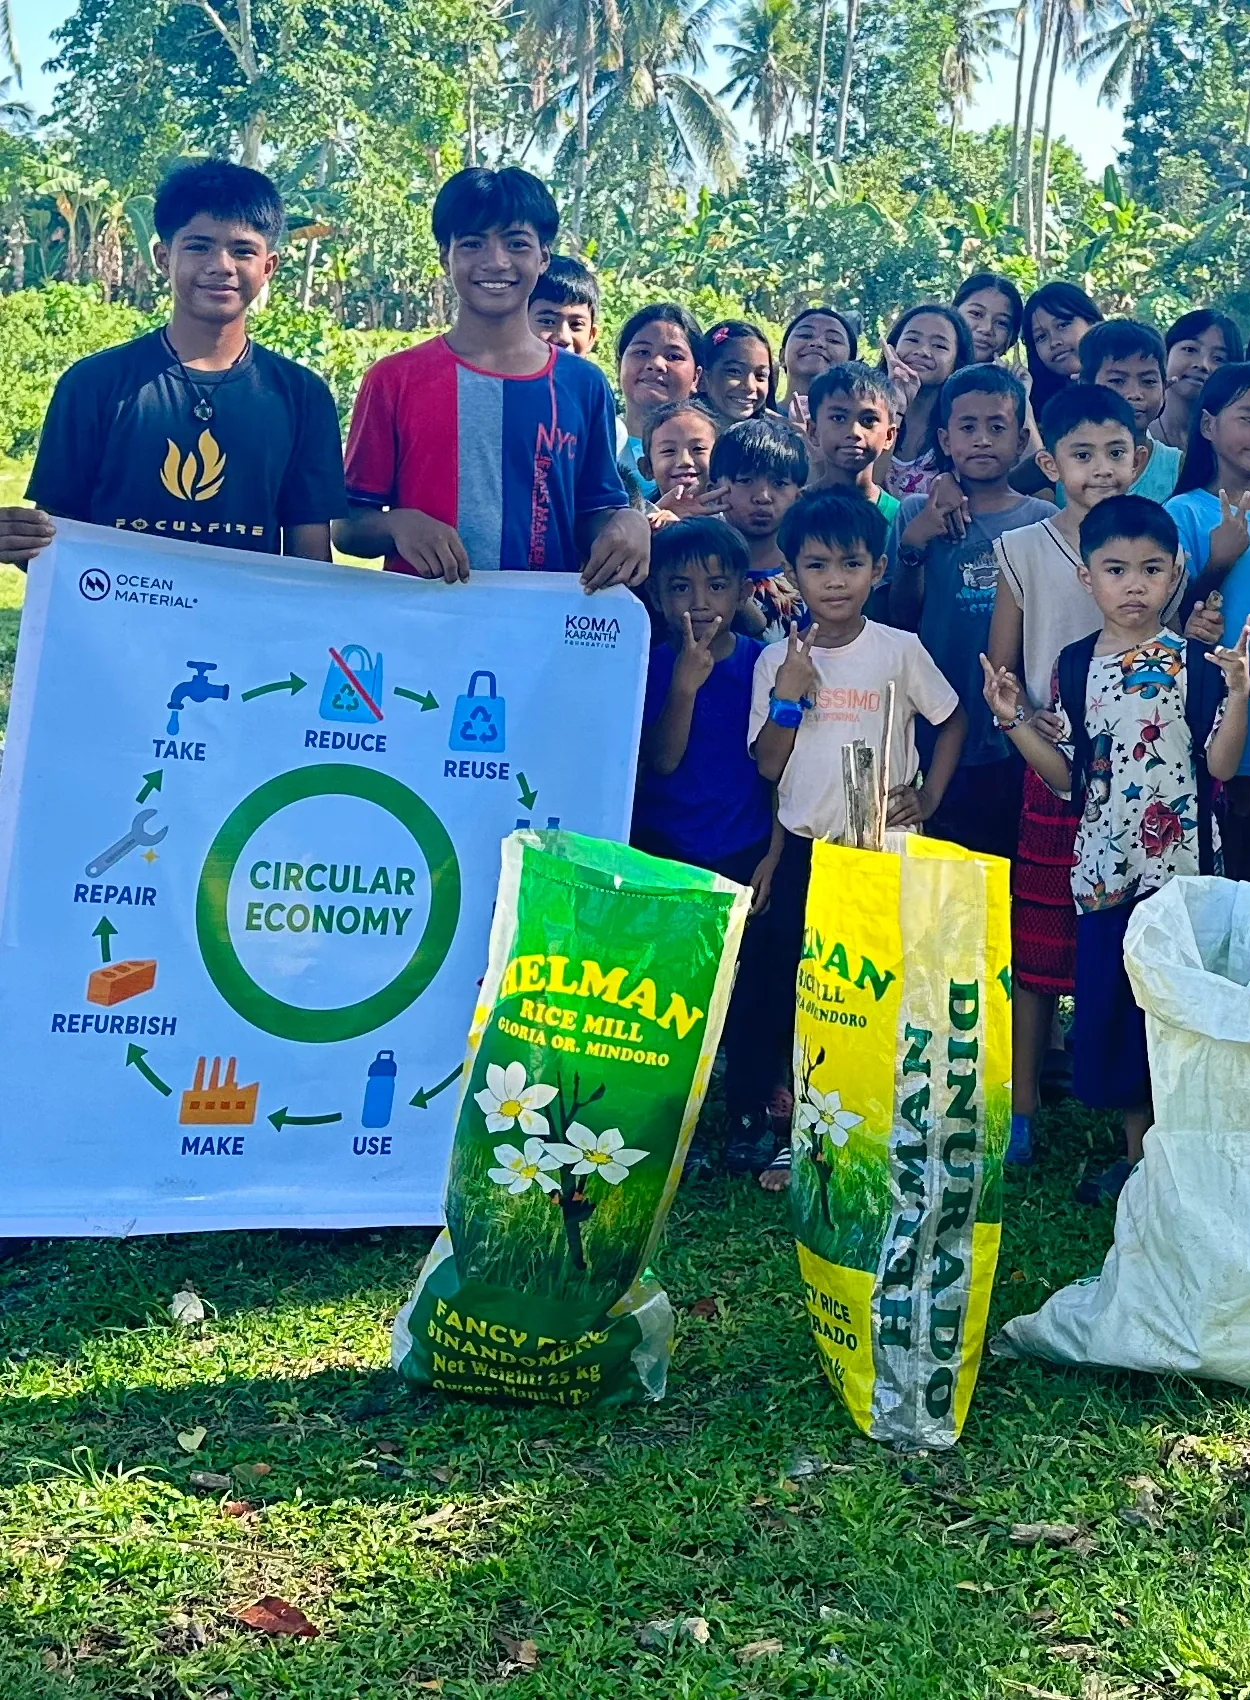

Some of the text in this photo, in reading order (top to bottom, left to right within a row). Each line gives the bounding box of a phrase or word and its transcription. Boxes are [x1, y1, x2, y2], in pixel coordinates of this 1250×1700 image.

[115, 518, 264, 537] FOCUSFIRE
[116, 574, 174, 591] OCEAN
[564, 629, 617, 643] KARANTH
[565, 614, 621, 634] KOMA
[152, 738, 207, 762] TAKE
[304, 729, 388, 753] REDUCE
[443, 760, 510, 781] REUSE
[249, 860, 416, 896] CIRCULAR
[73, 883, 157, 907] REPAIR
[245, 901, 414, 936] ECONOMY
[500, 954, 704, 1040] HELMAN
[51, 1013, 177, 1036] REFURBISH
[520, 998, 644, 1043] RICE MILL
[498, 1016, 670, 1067] GLORIA OR. MINDORO
[180, 1136, 246, 1156] MAKE
[352, 1136, 393, 1156] USE
[878, 1022, 933, 1351] HELMAN
[926, 978, 979, 1419] DINURADO
[820, 1292, 852, 1324] RICE
[436, 1298, 528, 1348] FANCY
[432, 1351, 466, 1374] Net
[548, 1370, 570, 1386] 25
